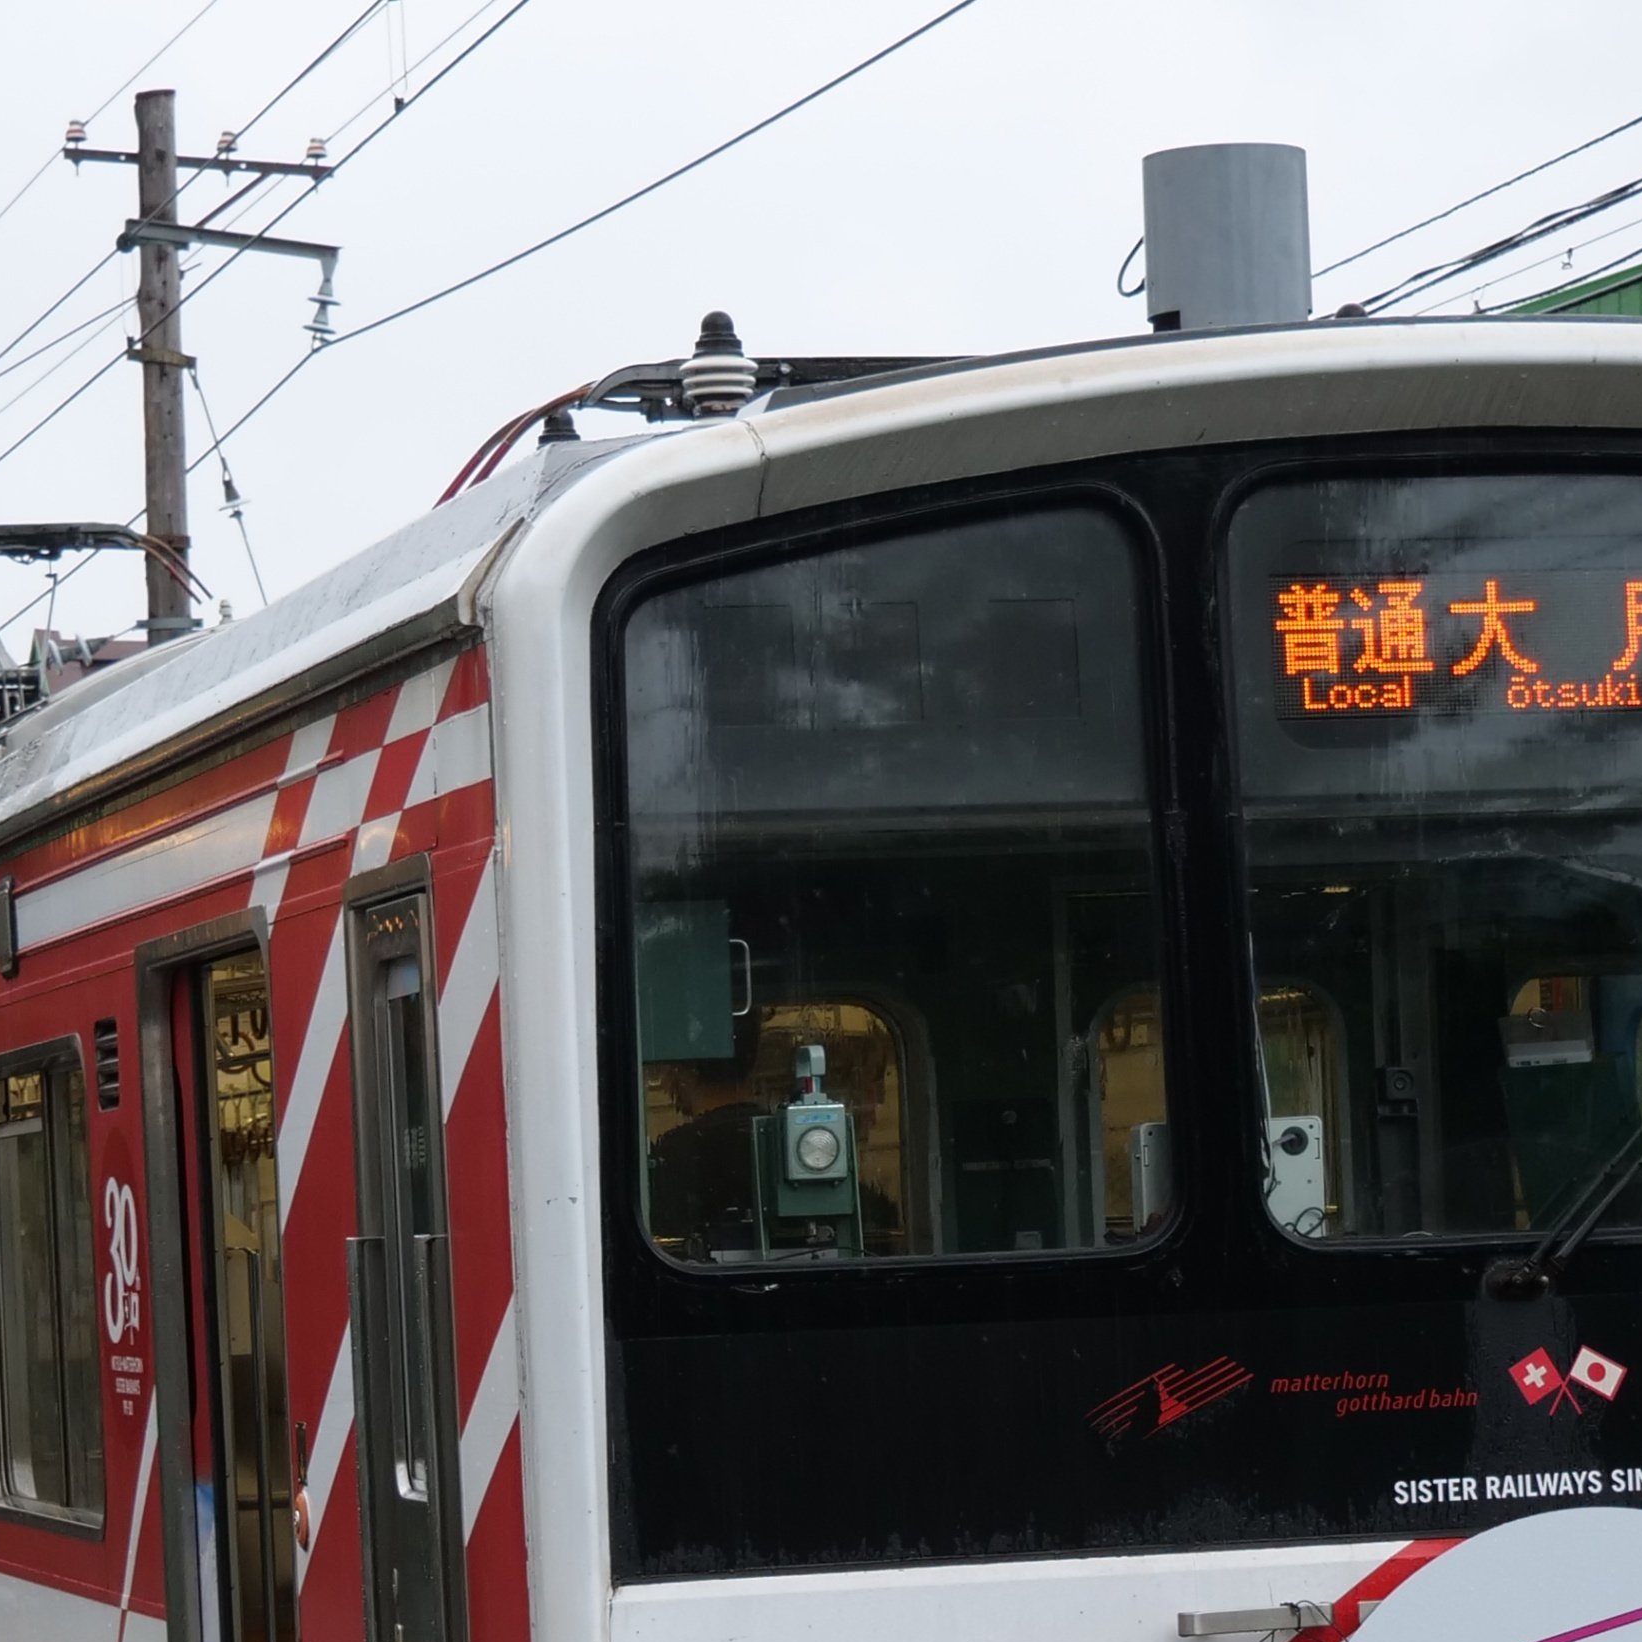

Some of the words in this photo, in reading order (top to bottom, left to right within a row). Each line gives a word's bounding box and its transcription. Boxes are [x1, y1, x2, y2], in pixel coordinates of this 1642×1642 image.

[1275, 582, 1435, 675] 普通
[1304, 676, 1413, 710] Local
[1270, 1371, 1390, 1393] matterhorn
[1335, 1389, 1426, 1418] gotthard
[1428, 1387, 1480, 1408] bahn
[1394, 1477, 1478, 1505] SISTER
[1485, 1470, 1603, 1500] RAILWAYS
